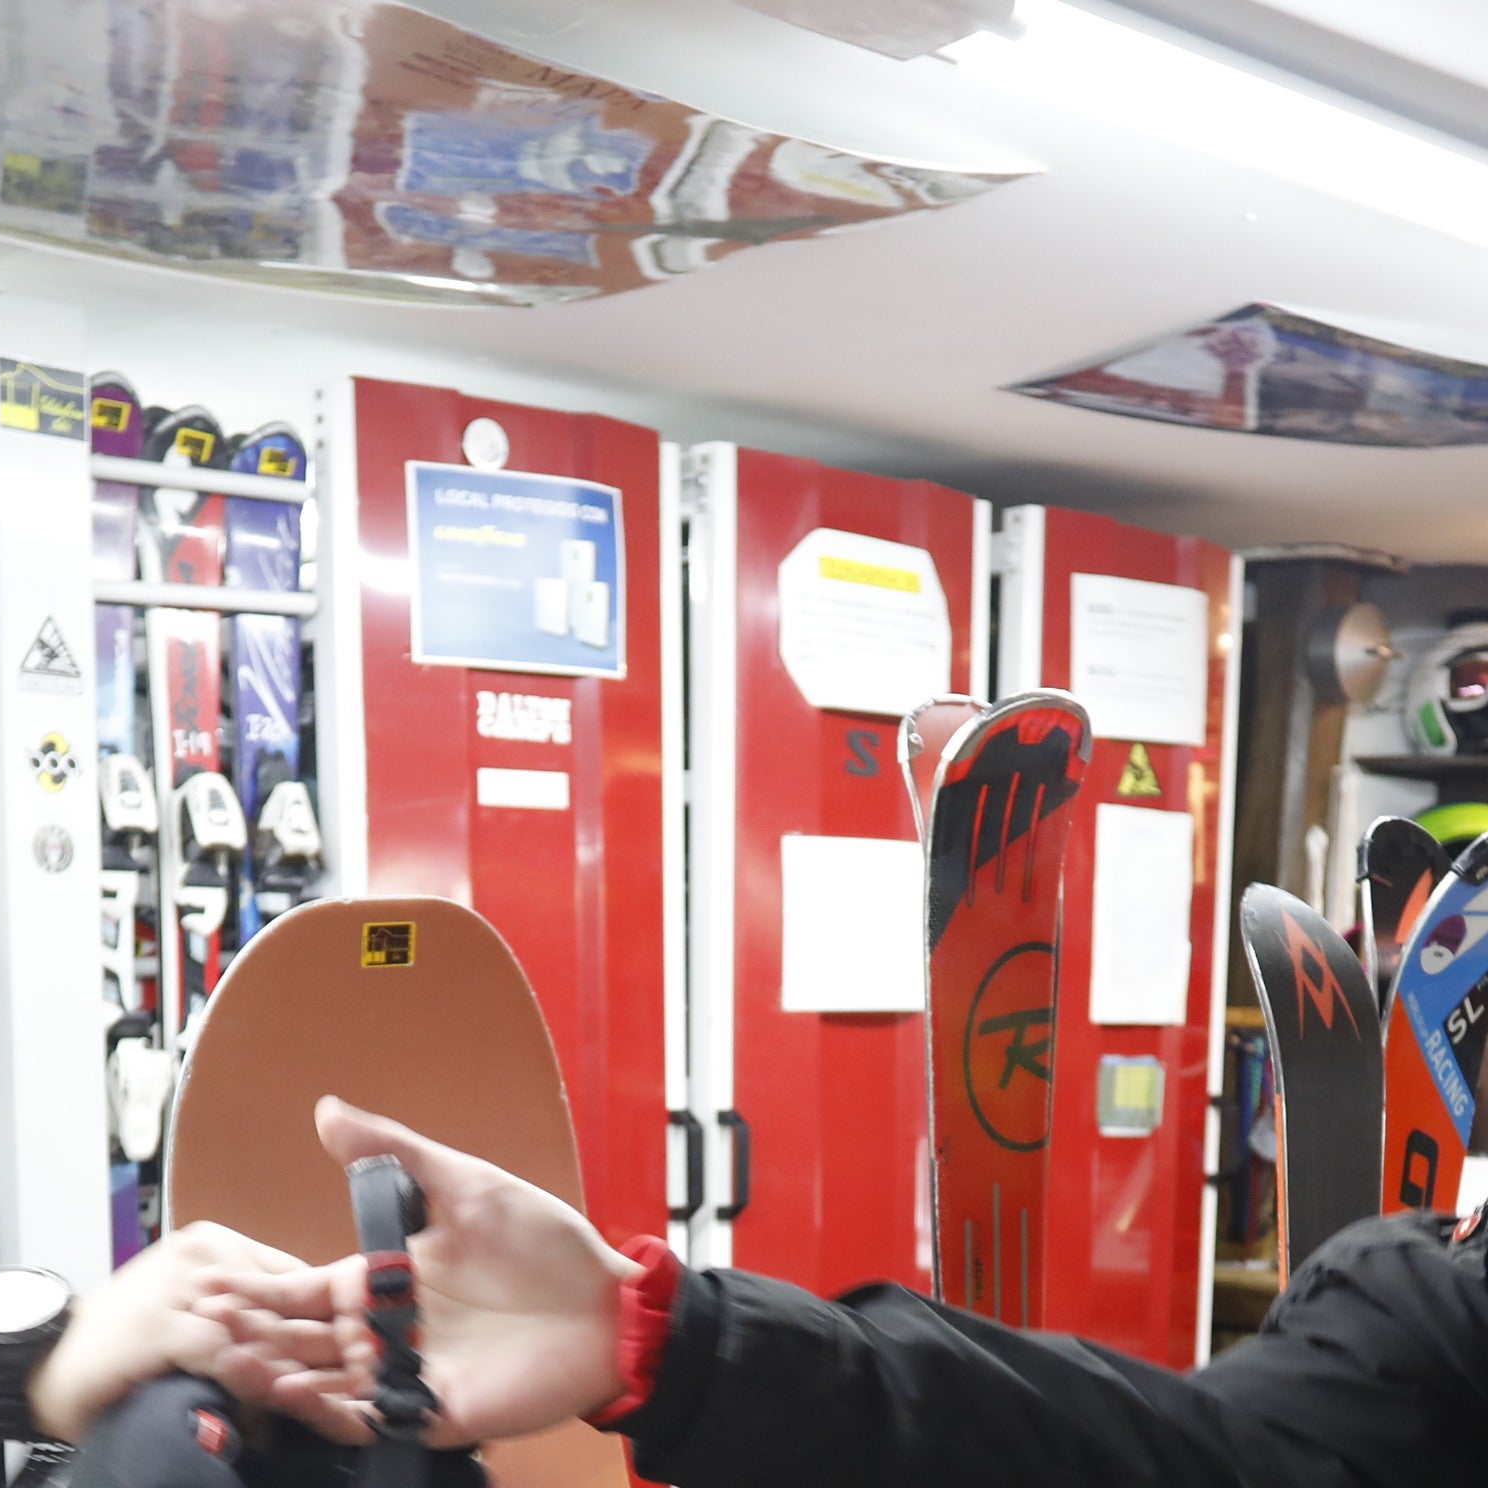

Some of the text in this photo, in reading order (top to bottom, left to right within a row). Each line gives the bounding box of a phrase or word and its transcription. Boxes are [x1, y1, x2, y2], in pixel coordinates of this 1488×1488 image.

[845, 729, 880, 777] S
[1446, 997, 1486, 1044] SL
[1424, 1029, 1469, 1117] RACING
